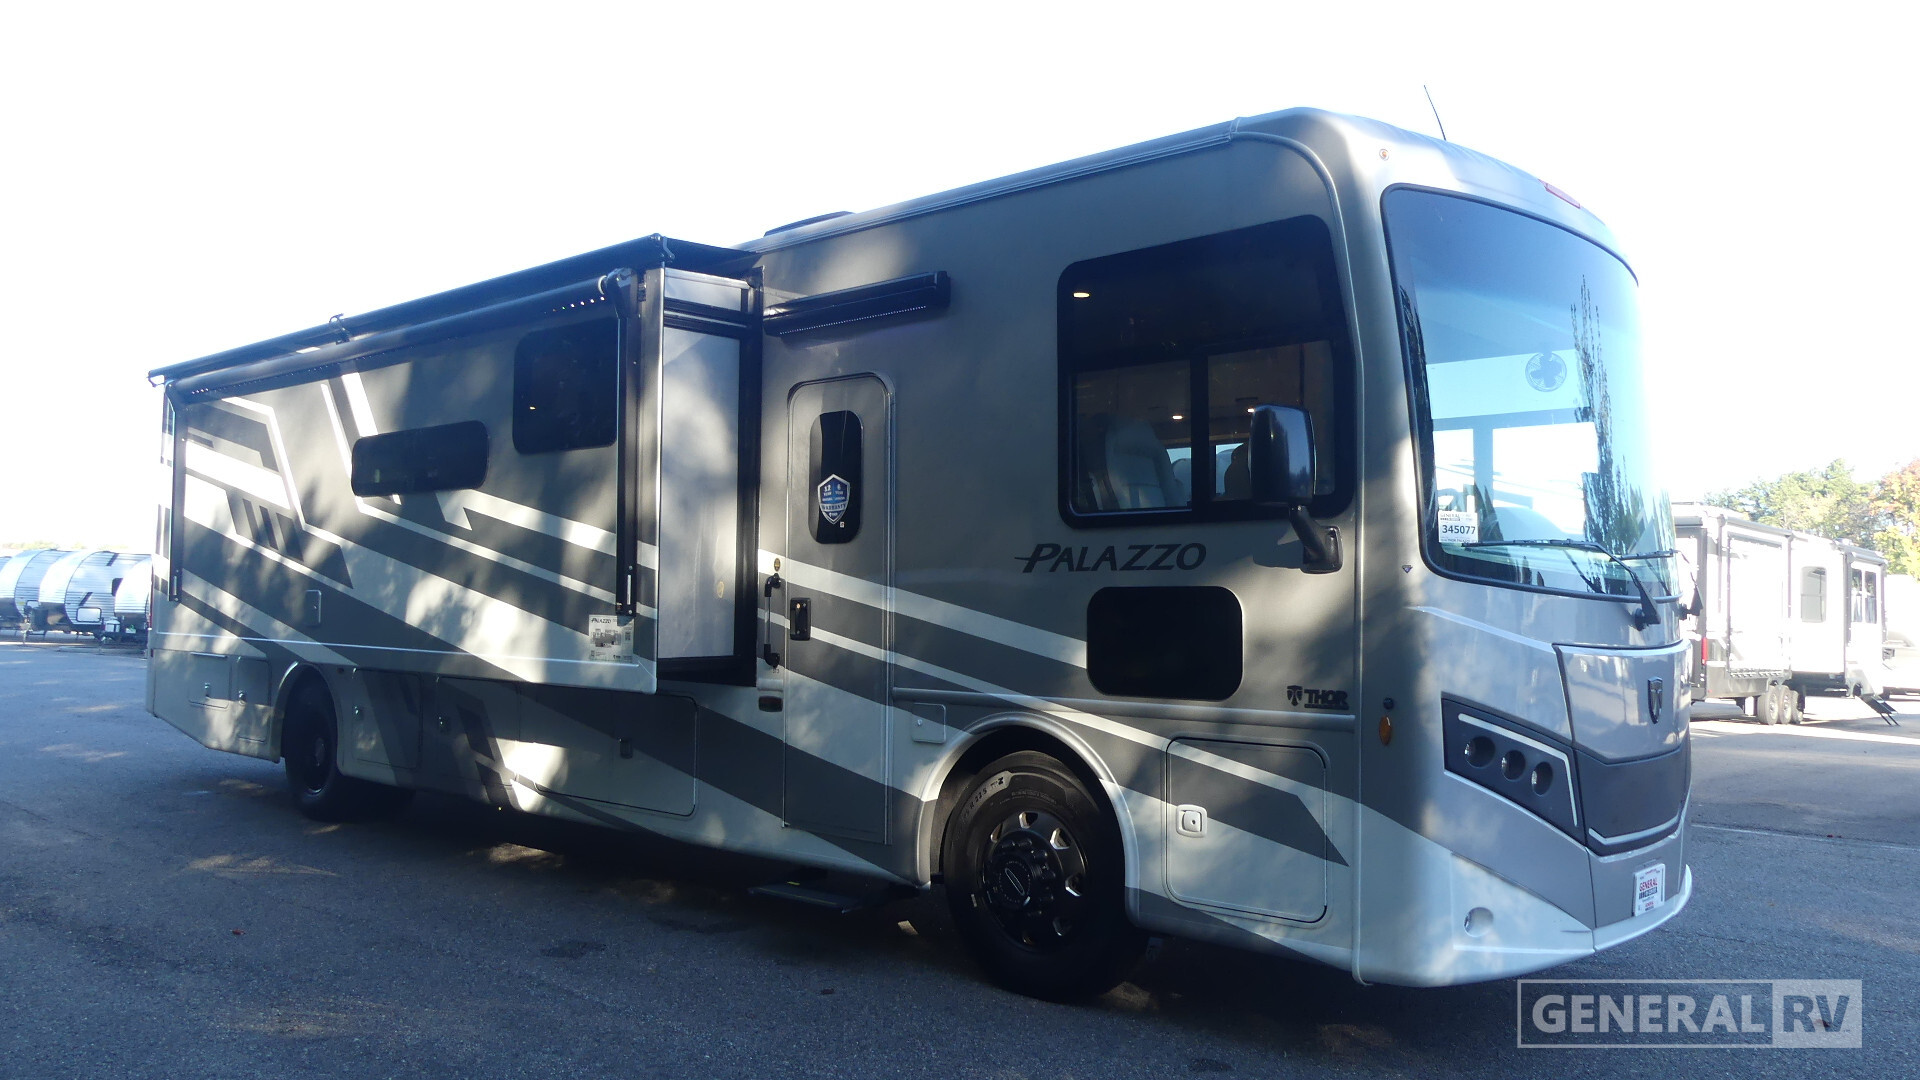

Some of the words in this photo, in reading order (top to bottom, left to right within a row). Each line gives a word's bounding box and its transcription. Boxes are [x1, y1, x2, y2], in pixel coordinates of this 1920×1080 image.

[1442, 524, 1476, 535] 345077
[1014, 542, 1207, 573] PALAZZO
[1304, 688, 1348, 705] THOR
